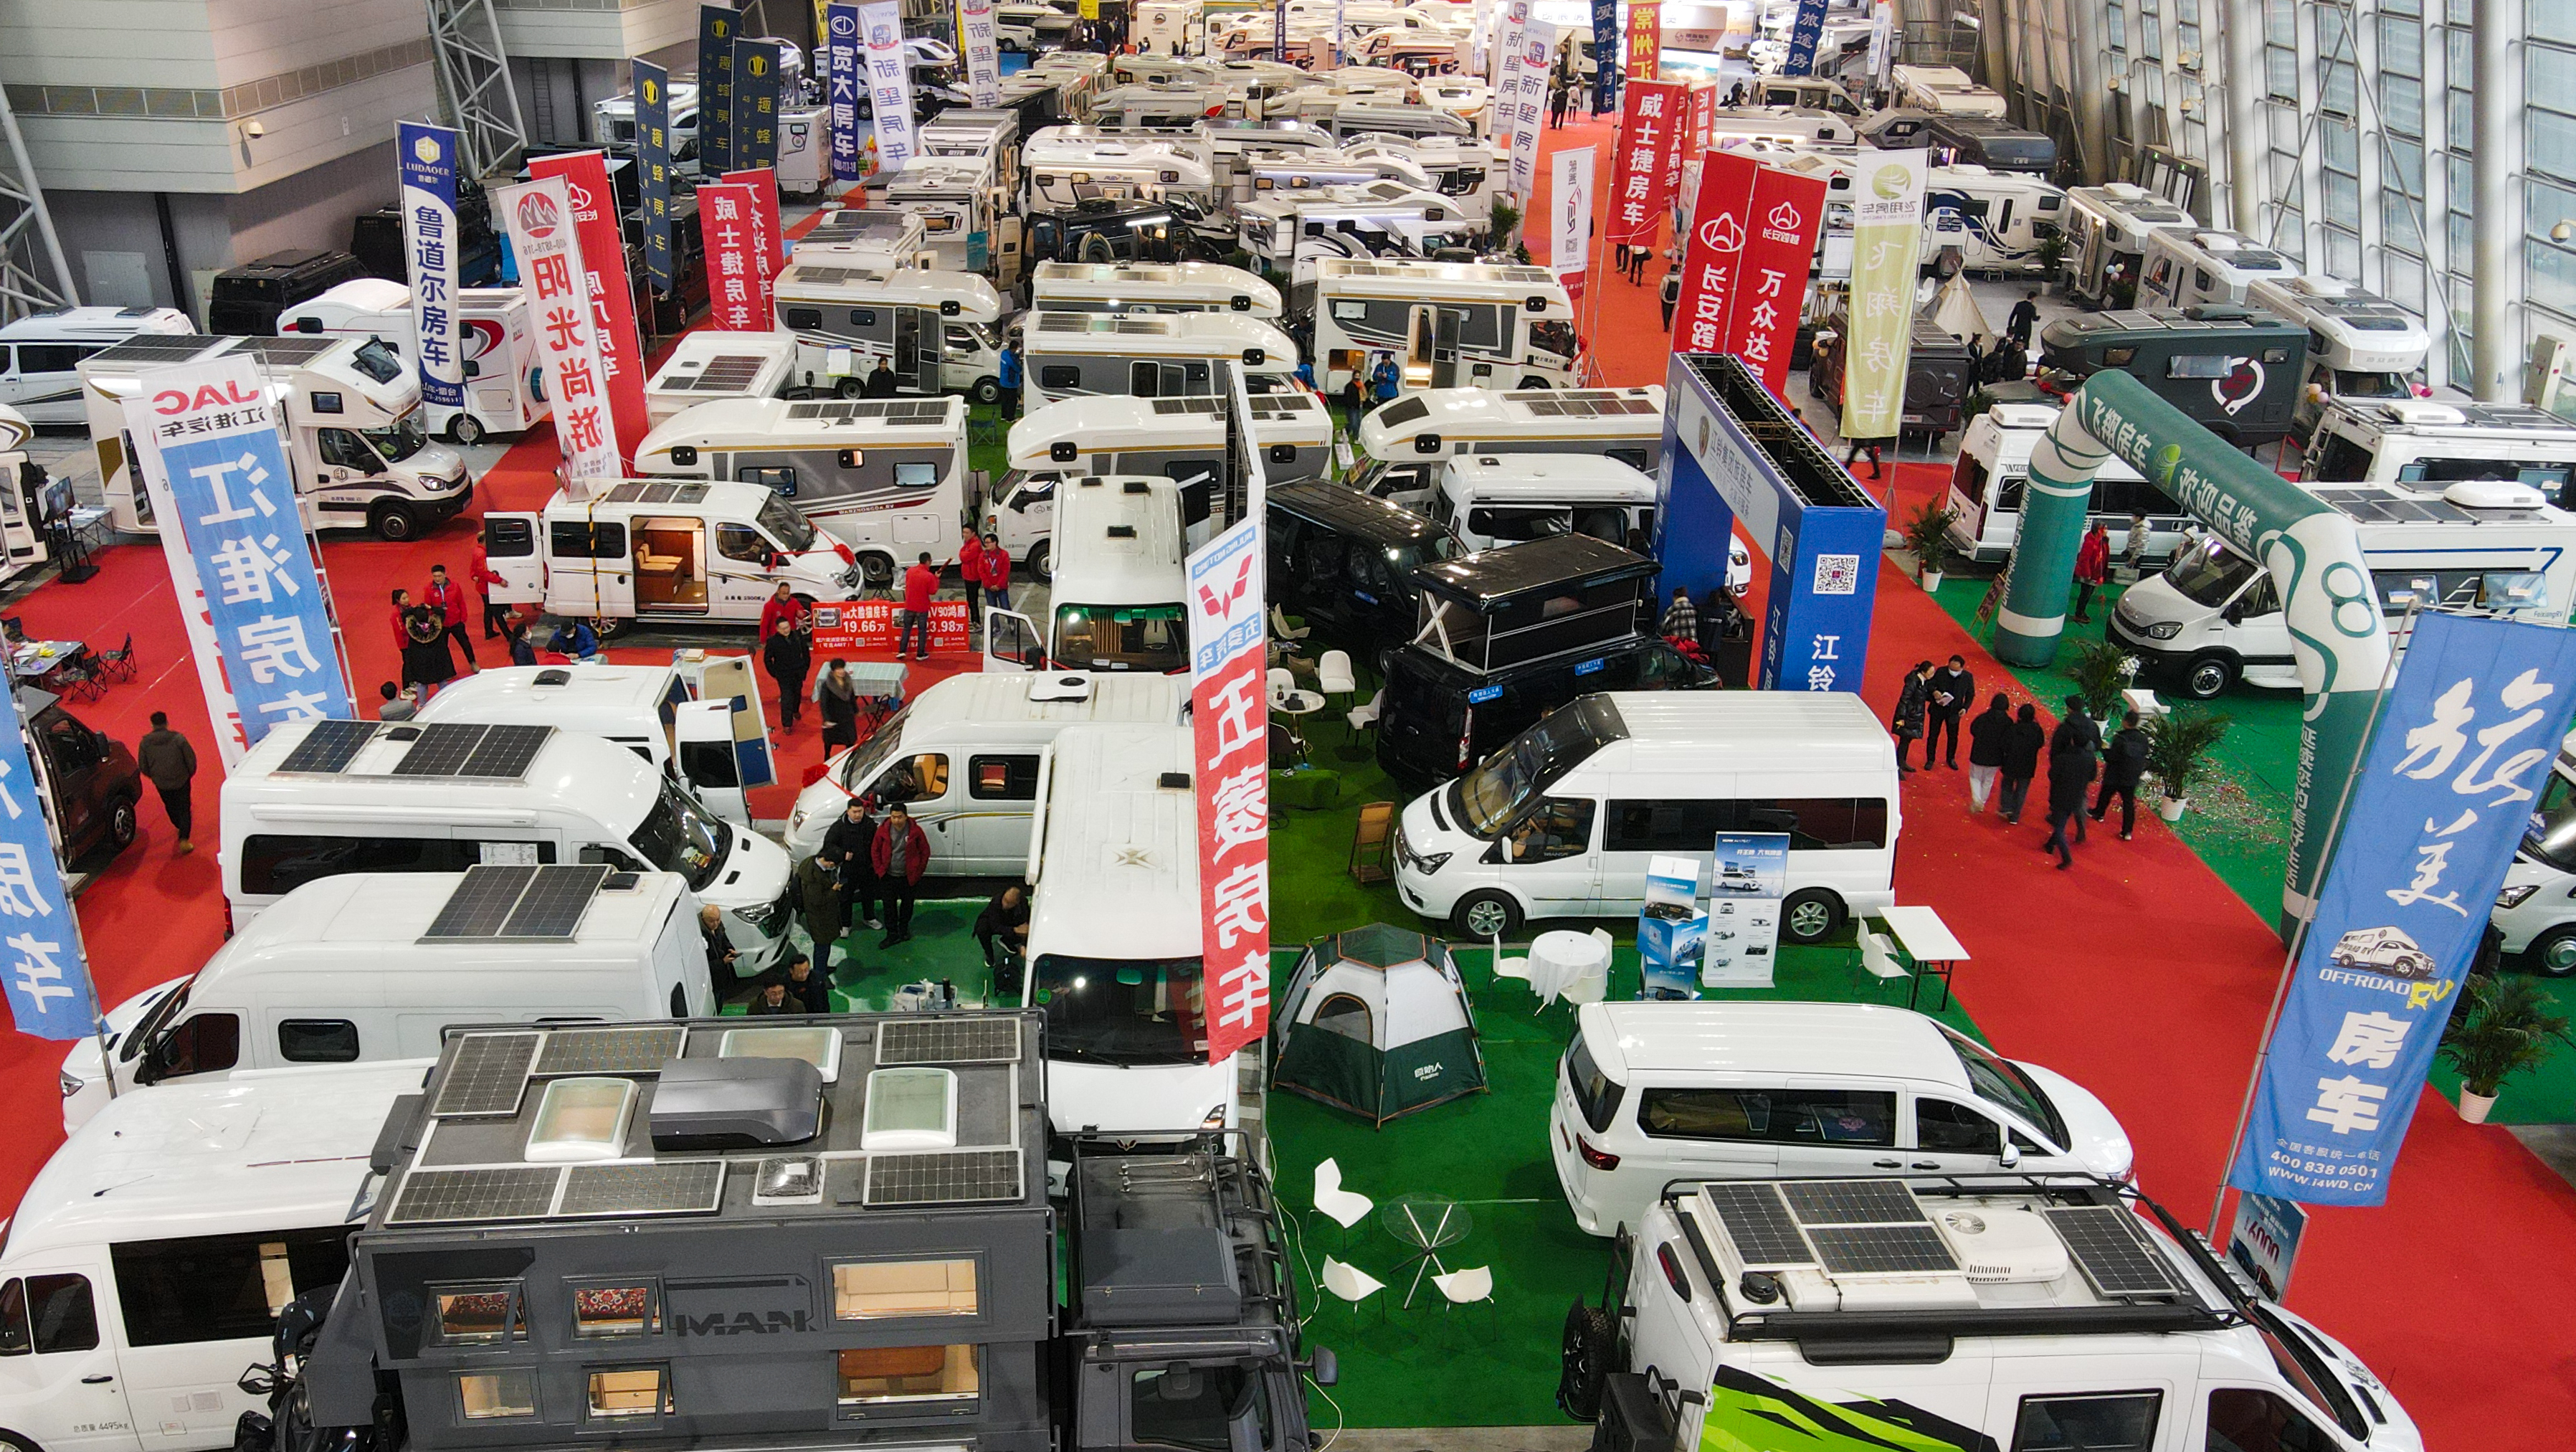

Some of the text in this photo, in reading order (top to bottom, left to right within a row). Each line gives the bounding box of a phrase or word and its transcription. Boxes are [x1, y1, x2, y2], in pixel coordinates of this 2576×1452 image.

[716, 55, 731, 149] 趣蜂房车
[831, 45, 855, 158] 宽大房车
[406, 162, 450, 176] LUDAOER
[652, 128, 666, 251] 趣蜂房车
[1622, 93, 1664, 226] 威士捷房车
[414, 206, 450, 367] 鲁道尔房车
[2091, 398, 2153, 471] 飞翔房车
[2177, 468, 2259, 554] 欢迎品鉴
[843, 622, 886, 635] 19.66万
[1807, 634, 1840, 691] 江铃
[2318, 968, 2411, 995] OFFROAD
[2306, 1010, 2413, 1135] 房车
[2271, 1150, 2378, 1180] 400 838 0501
[675, 1311, 817, 1338] MAN
